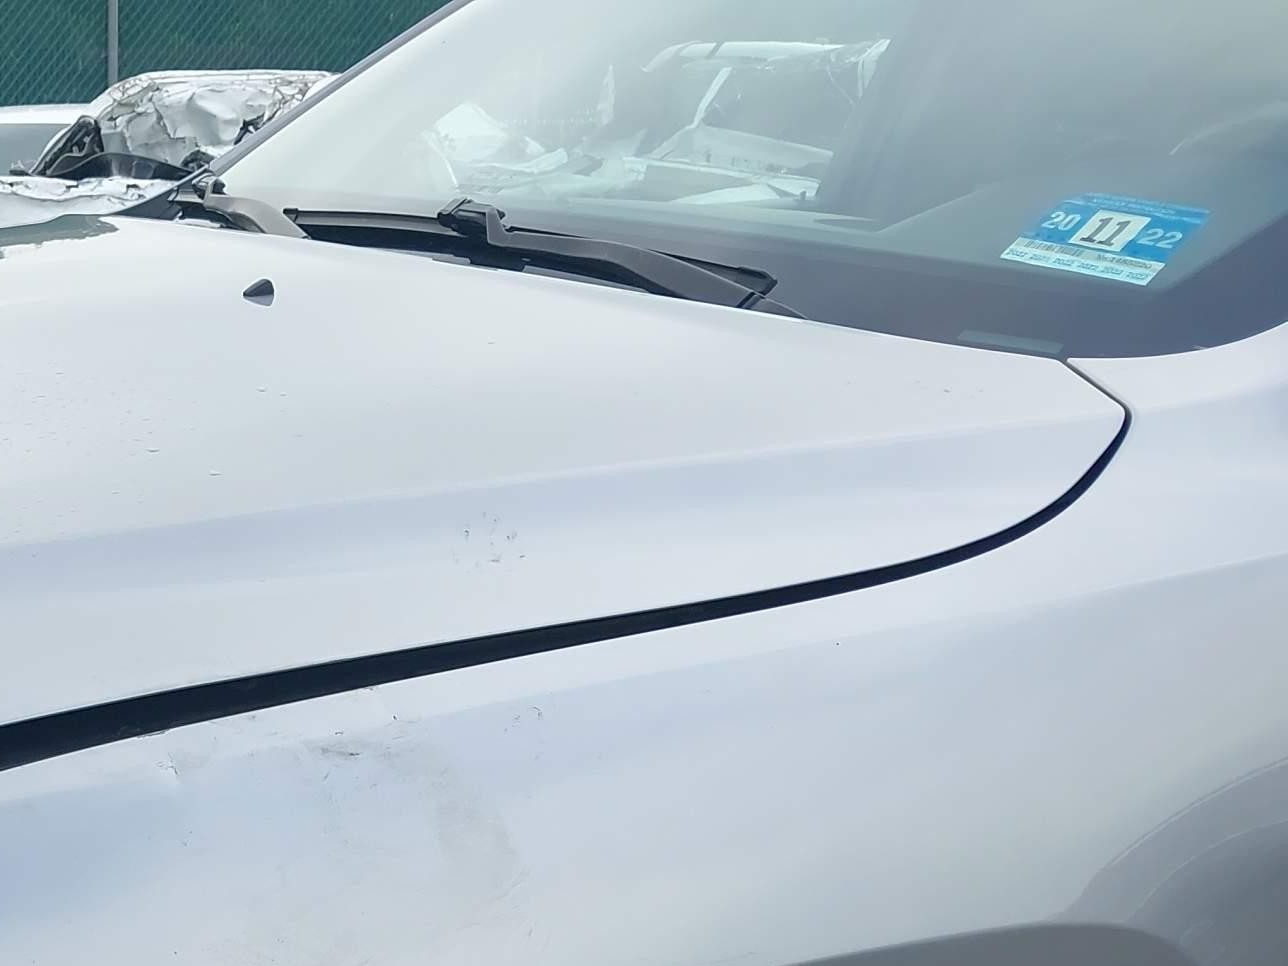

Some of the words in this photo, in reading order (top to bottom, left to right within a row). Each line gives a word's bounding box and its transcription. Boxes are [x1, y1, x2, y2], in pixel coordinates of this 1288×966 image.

[1042, 211, 1081, 231] 20
[1079, 217, 1131, 246] 11
[1137, 228, 1183, 249] 22
